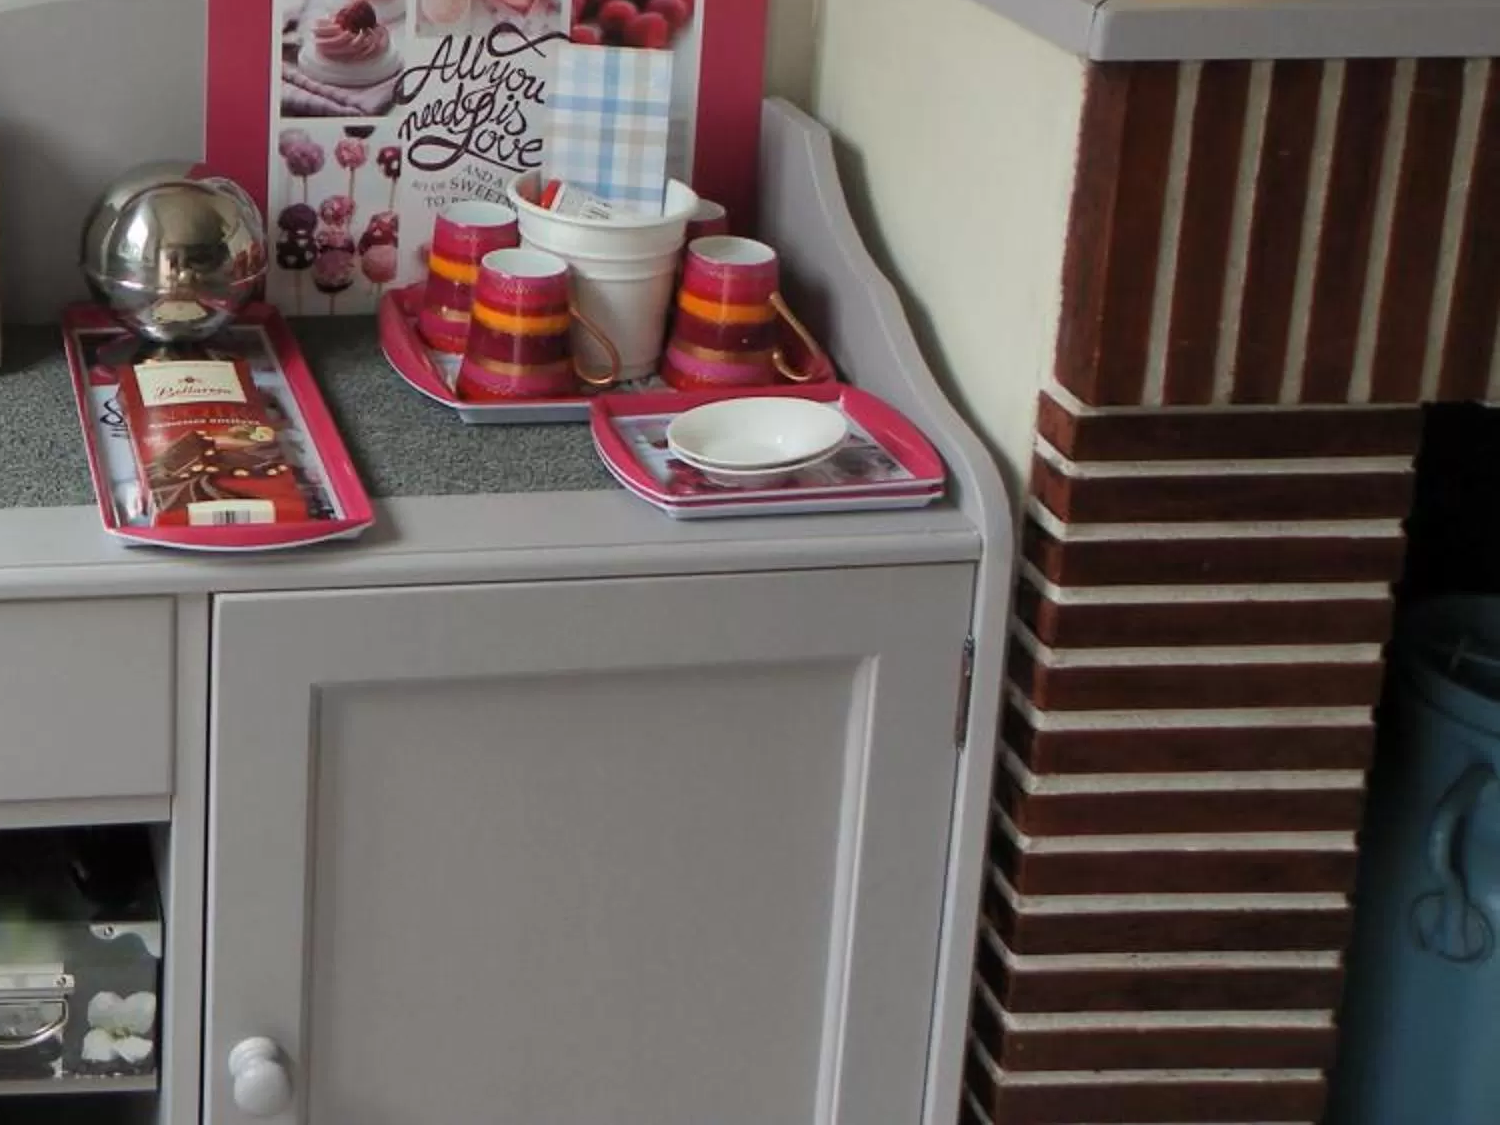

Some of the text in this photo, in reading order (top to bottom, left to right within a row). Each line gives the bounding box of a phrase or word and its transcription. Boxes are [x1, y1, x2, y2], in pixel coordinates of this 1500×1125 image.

[388, 33, 546, 106] All you
[397, 82, 528, 141] need is
